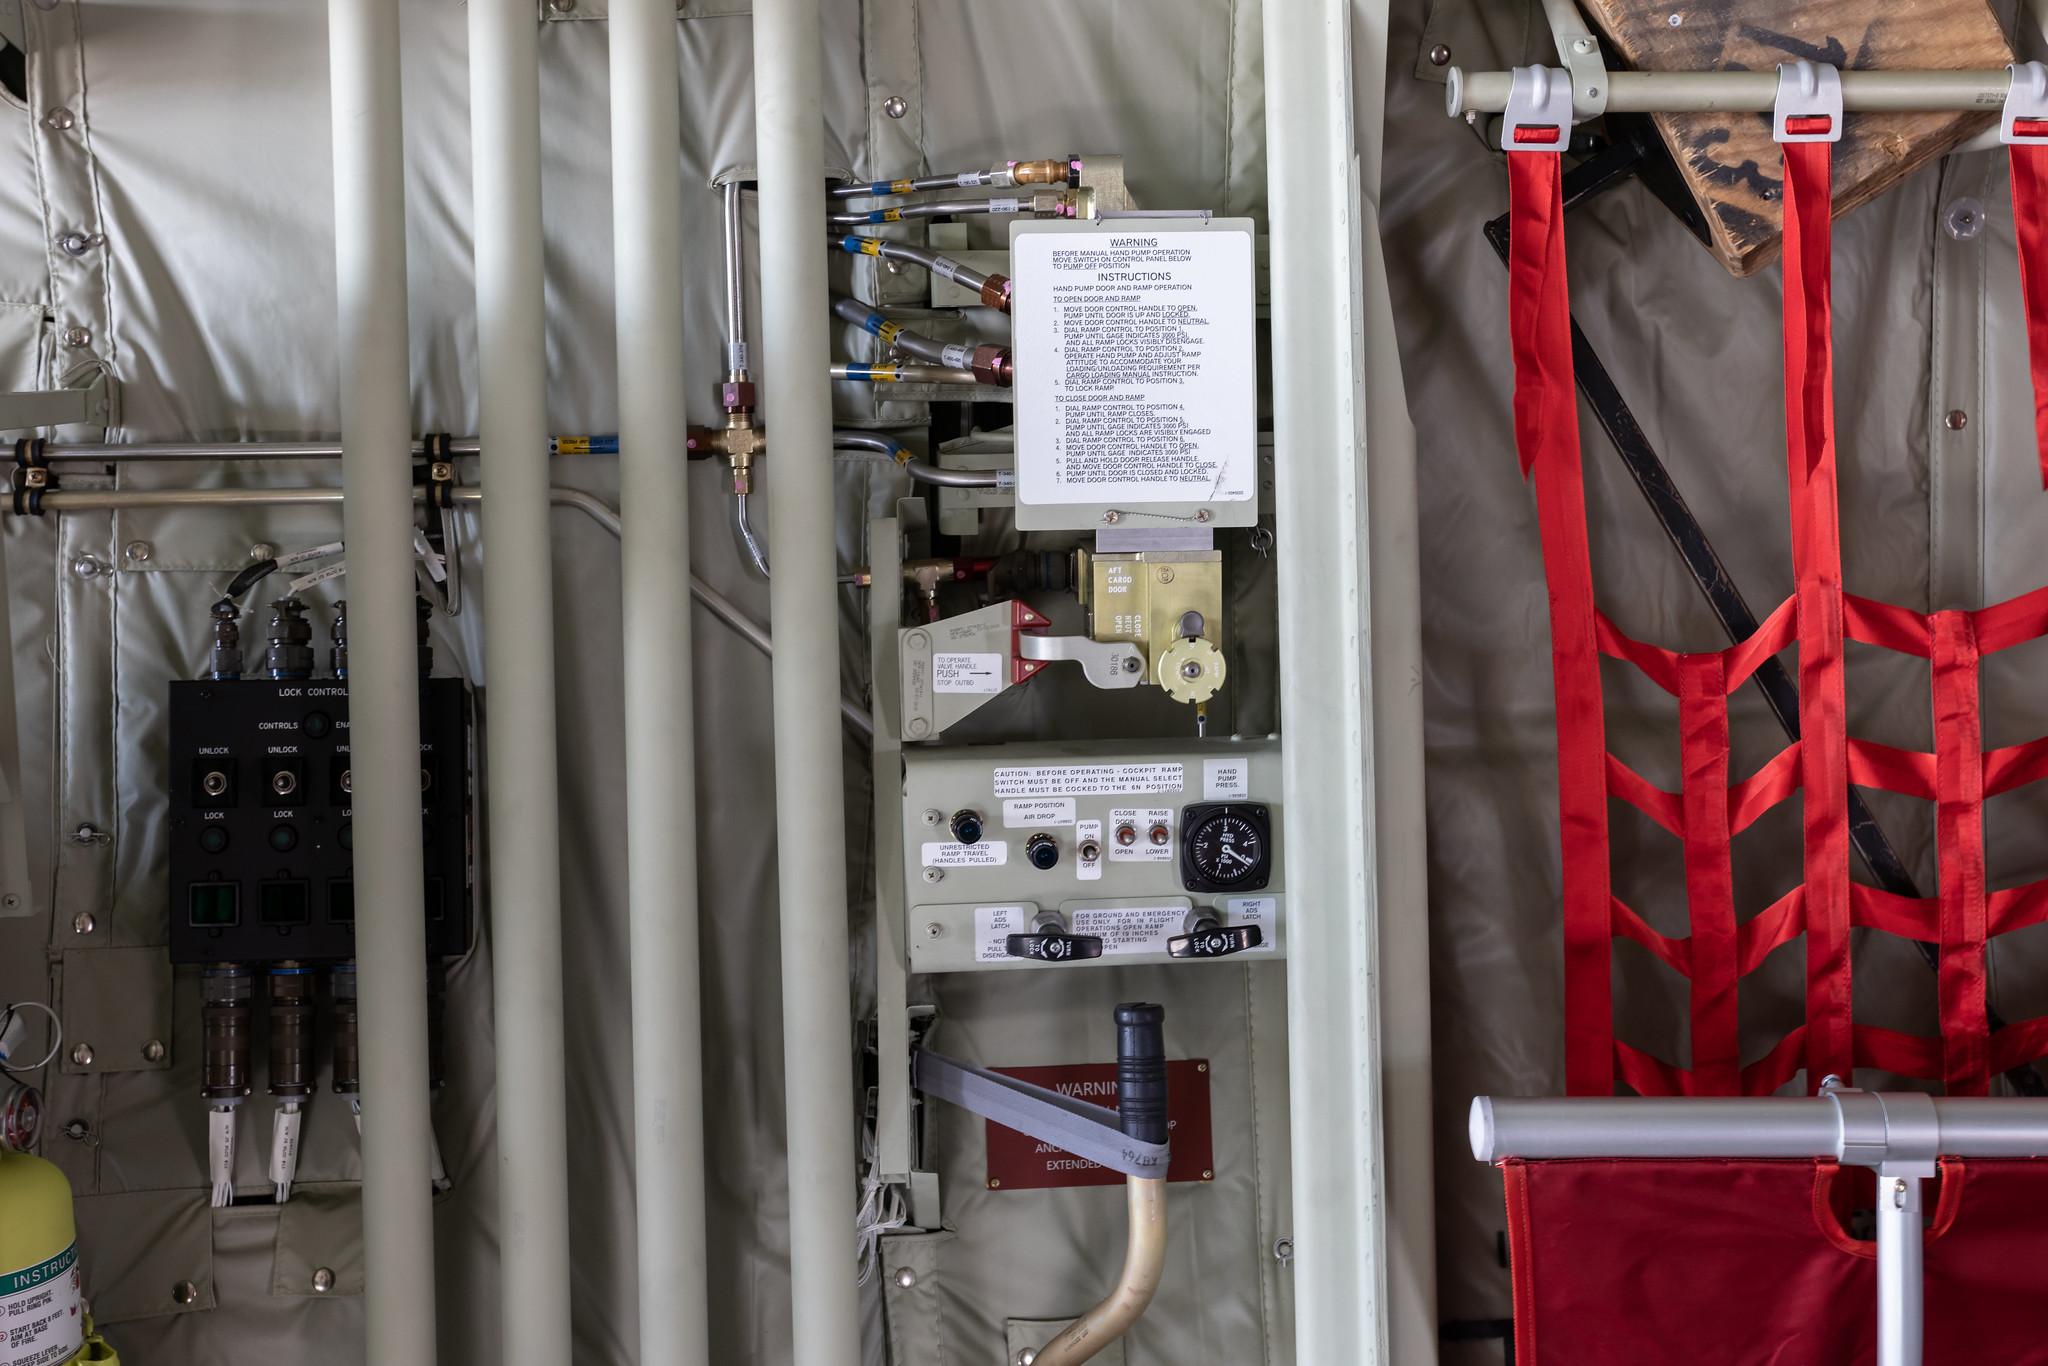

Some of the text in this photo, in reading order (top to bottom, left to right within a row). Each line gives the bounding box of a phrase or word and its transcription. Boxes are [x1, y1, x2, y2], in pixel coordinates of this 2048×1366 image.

[1110, 238, 1158, 247] WARNING
[1098, 272, 1172, 282] INSTRUCTIONS
[279, 688, 349, 696] LOCK CONTROL
[1056, 1081, 1118, 1096] WARNIN
[14, 1248, 75, 1289] INSTRUCT
[8, 1300, 26, 1310] HOLD
[9, 1309, 25, 1317] PULL
[27, 1301, 41, 1311] RING
[10, 1324, 30, 1336] START
[32, 1318, 47, 1329] BACK
[11, 1334, 23, 1342] AIM
[34, 1324, 48, 1335] BASE
[13, 1352, 40, 1366] SQUEEZE
